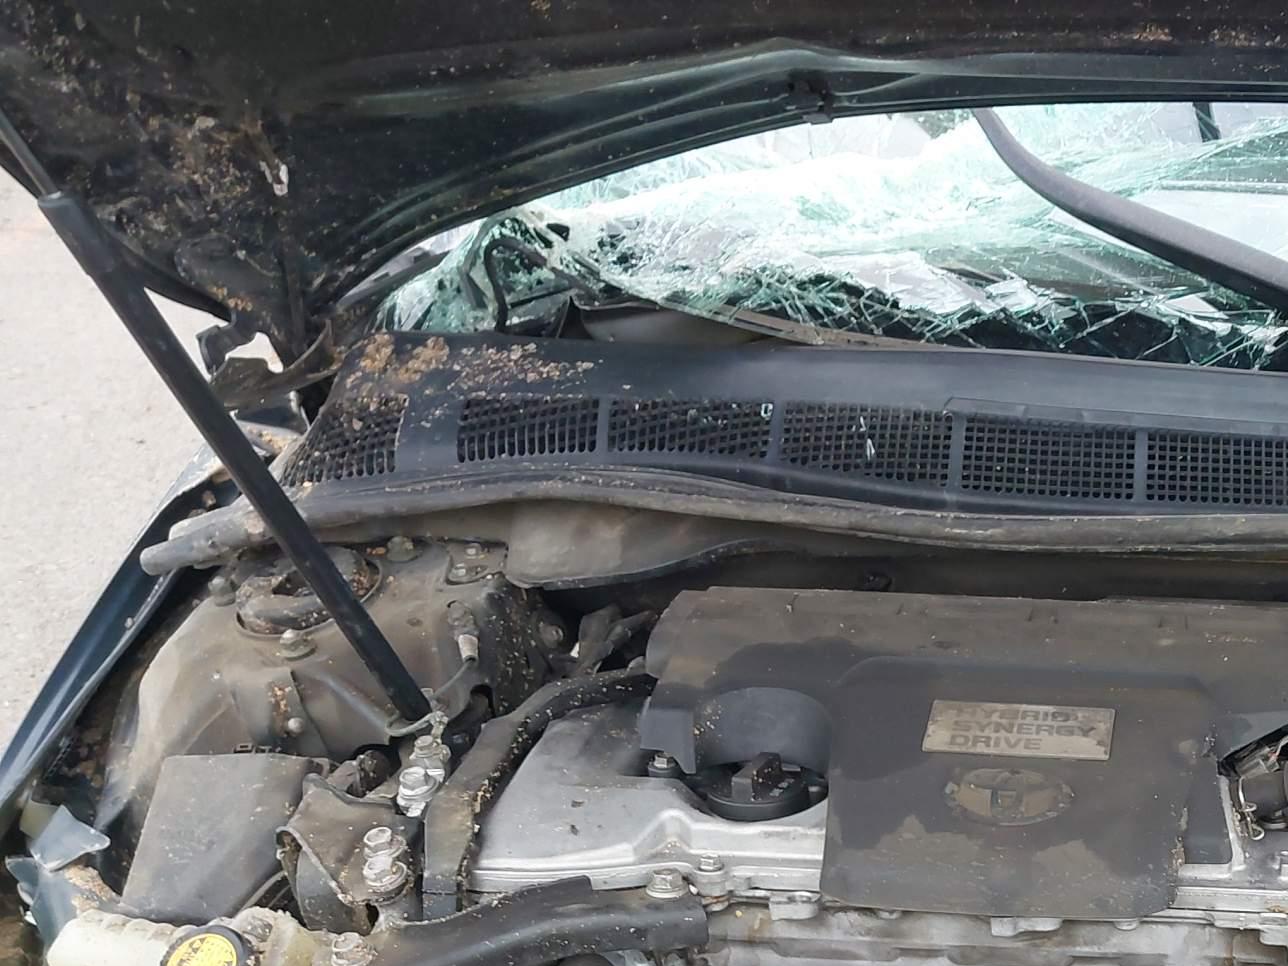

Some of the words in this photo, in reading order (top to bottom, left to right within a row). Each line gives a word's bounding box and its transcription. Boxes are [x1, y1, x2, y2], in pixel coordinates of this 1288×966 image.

[955, 708, 1073, 723] HYBRID
[952, 720, 1096, 737] SYNERGY
[949, 734, 1042, 750] DRIVE
